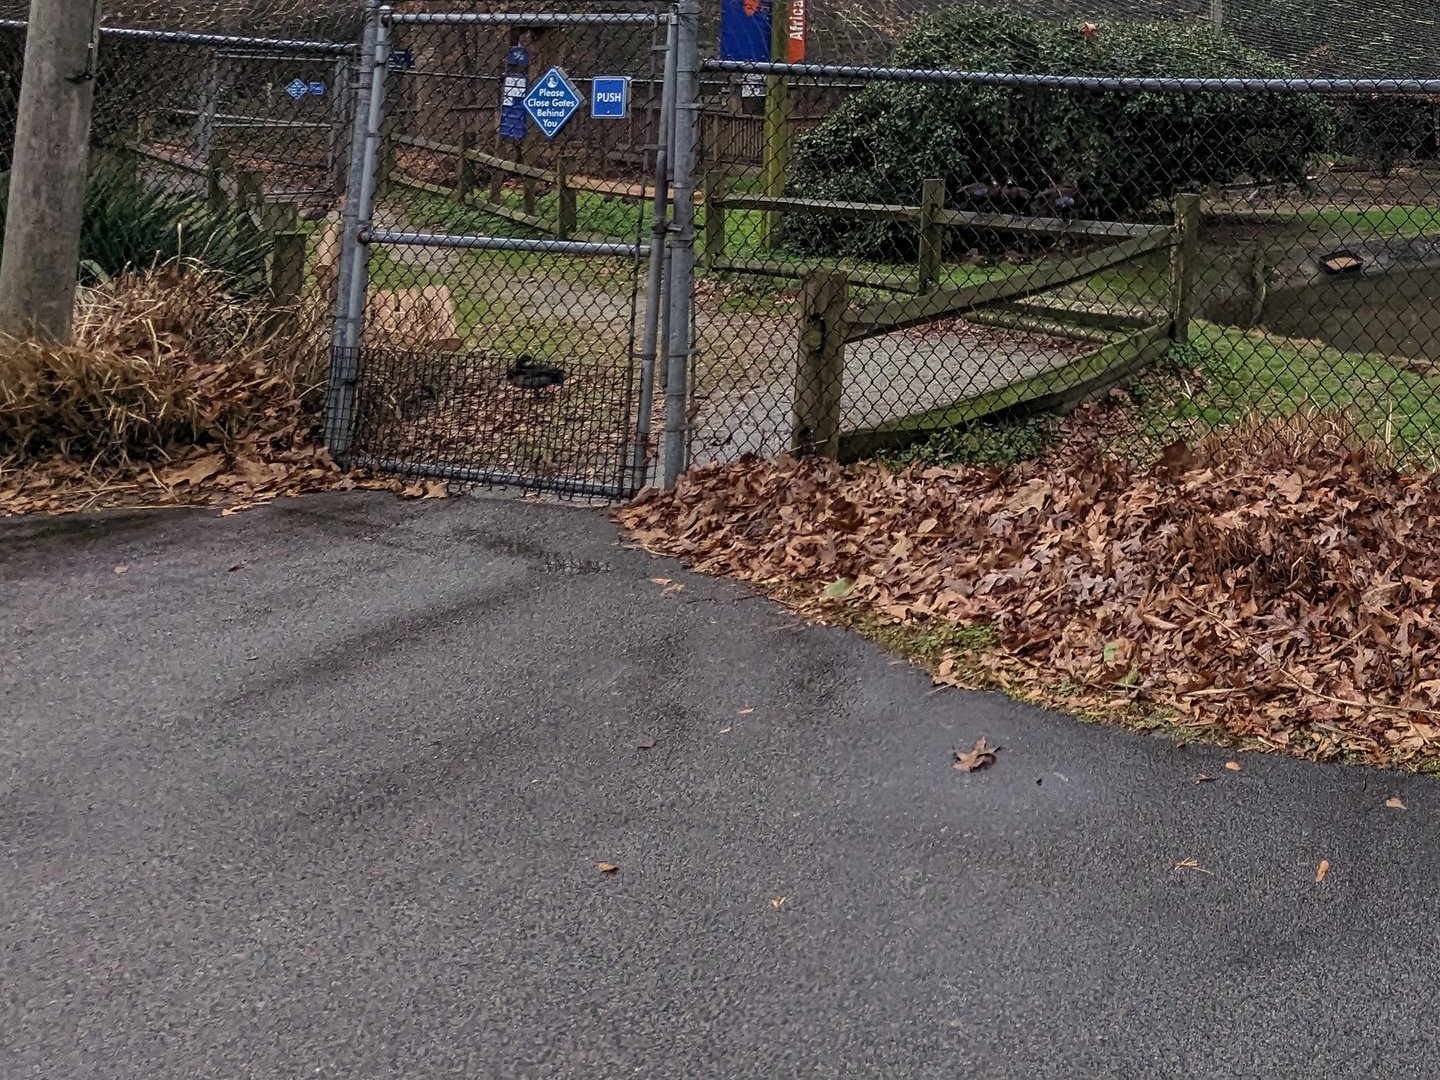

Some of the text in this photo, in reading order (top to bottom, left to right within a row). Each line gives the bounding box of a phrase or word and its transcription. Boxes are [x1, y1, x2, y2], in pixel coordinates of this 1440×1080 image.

[789, 0, 804, 41] Africa
[538, 88, 565, 97] Please
[596, 93, 621, 102] PUSH
[527, 98, 575, 107] Close Gates
[536, 108, 565, 117] Behind
[542, 118, 558, 127] You
